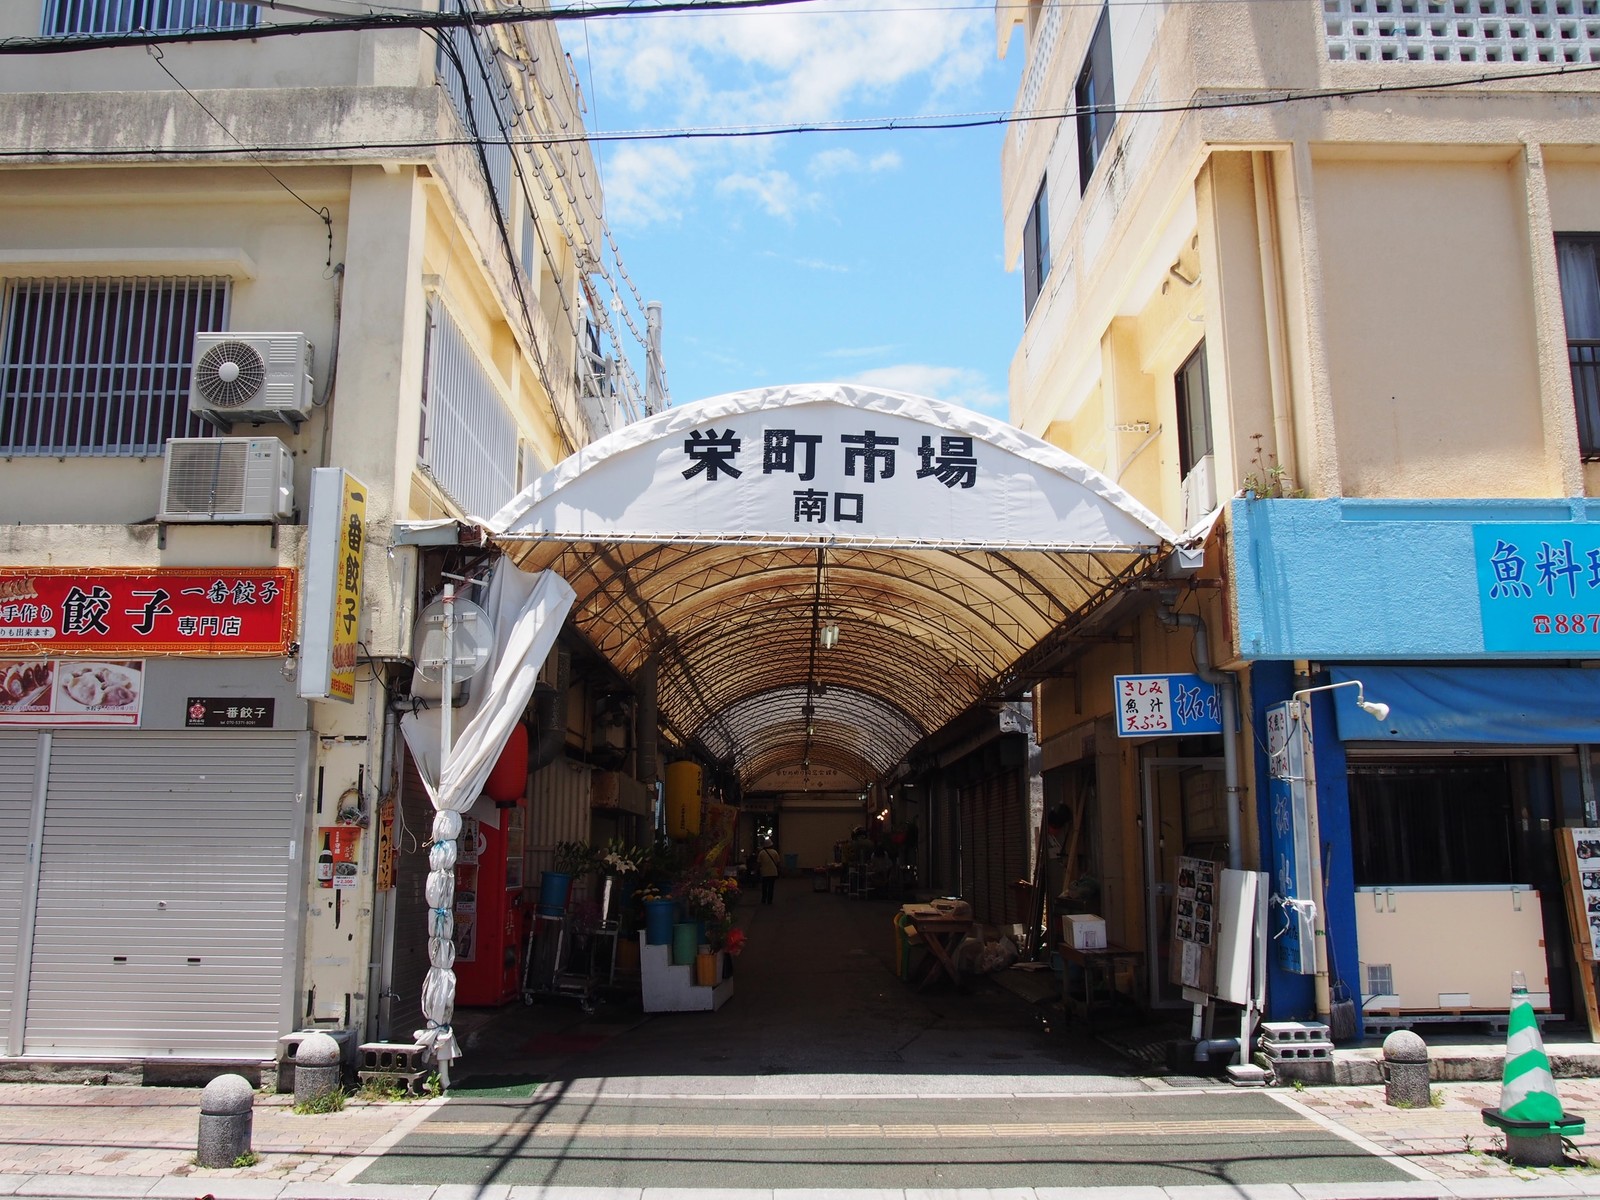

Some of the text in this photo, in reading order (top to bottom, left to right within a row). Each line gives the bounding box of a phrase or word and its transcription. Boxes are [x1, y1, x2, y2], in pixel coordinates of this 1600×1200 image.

[681, 428, 978, 489] 栄町市場
[793, 488, 865, 524] 南口
[342, 491, 364, 636] 一番餃子
[181, 579, 280, 605] 一番餃子
[0, 603, 54, 623] 手作り
[61, 585, 174, 636] 餃子
[177, 615, 242, 636] 専門店
[1125, 680, 1163, 697] さしみ
[212, 706, 267, 719] 一番餃子
[1125, 697, 1164, 714] 魚汁
[1126, 714, 1168, 731] 天ぷら
